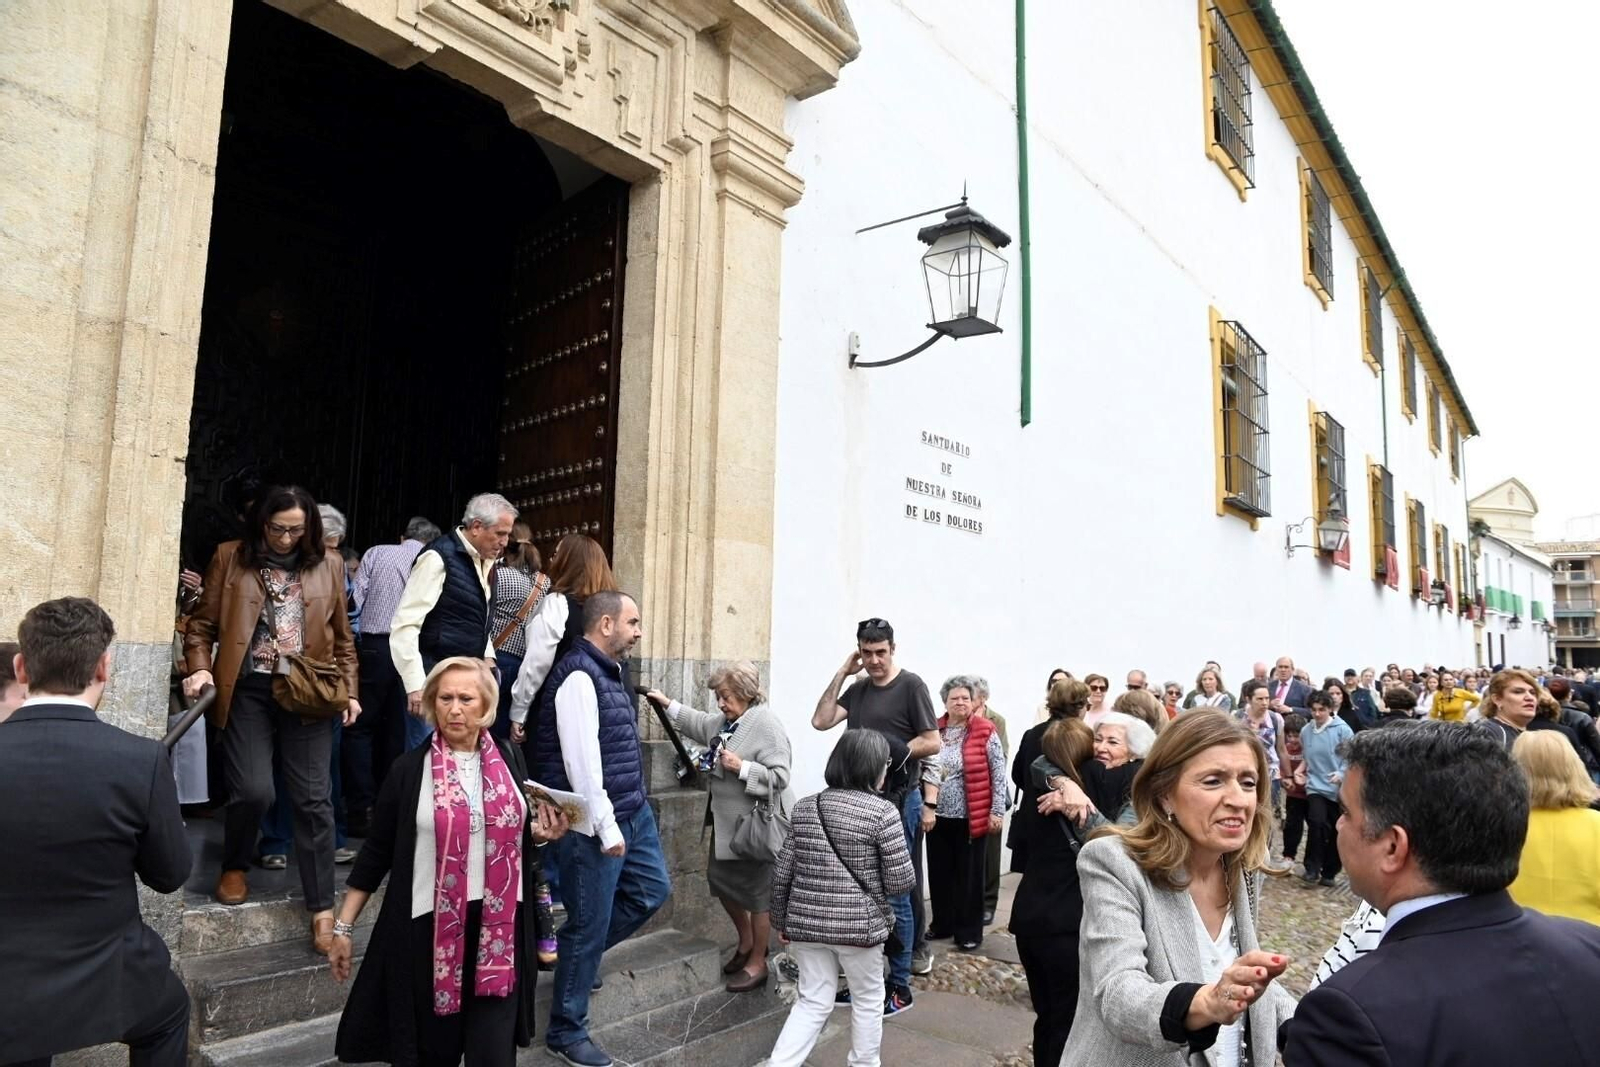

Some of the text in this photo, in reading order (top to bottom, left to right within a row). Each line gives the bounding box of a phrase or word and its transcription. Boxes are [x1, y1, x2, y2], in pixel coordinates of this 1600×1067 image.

[921, 430, 970, 457] SANTUARIO
[941, 462, 952, 475] DE
[906, 477, 982, 508] NUESTRA SEÑORA
[906, 504, 983, 532] DE LOS DOLORES
